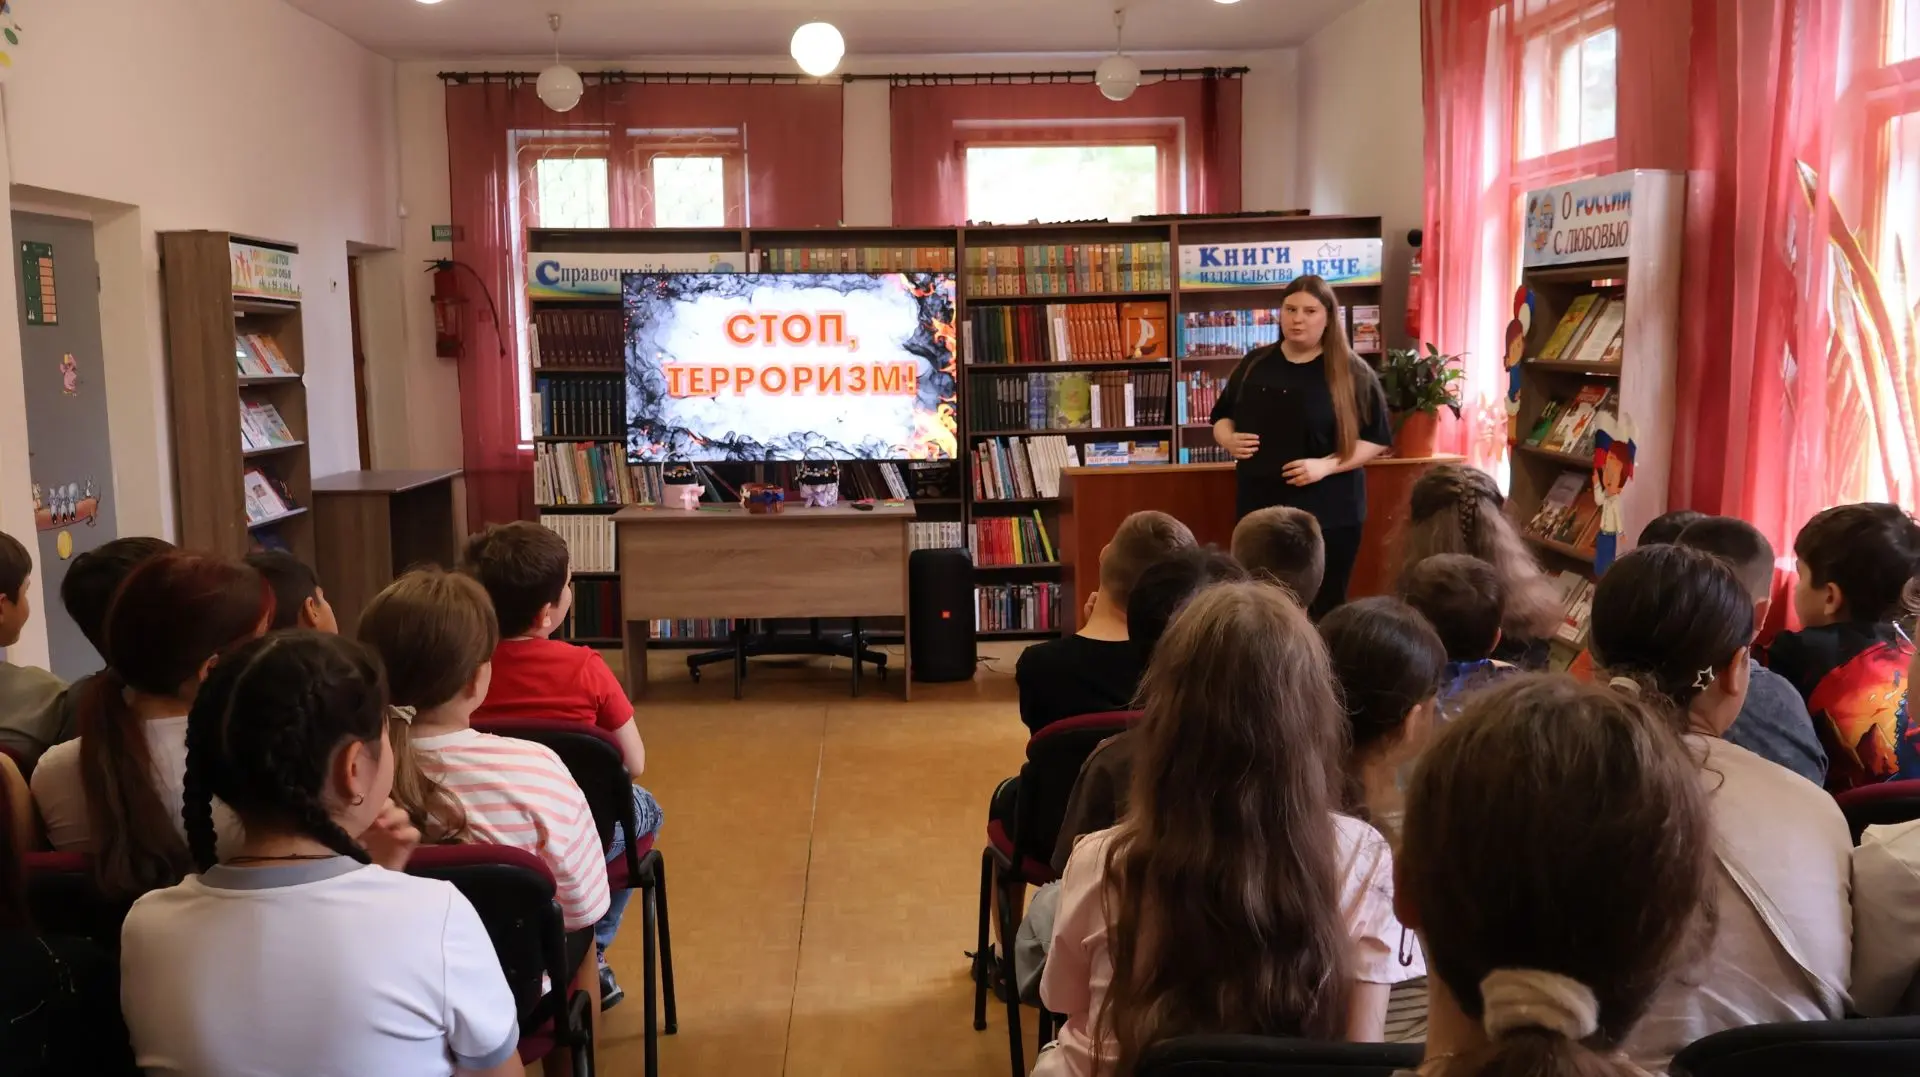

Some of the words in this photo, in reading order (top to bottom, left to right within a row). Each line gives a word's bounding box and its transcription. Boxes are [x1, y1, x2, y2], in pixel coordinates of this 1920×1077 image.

[1562, 191, 1572, 220] О
[1554, 230, 1563, 255] С
[1564, 220, 1629, 254] ЛЮБОВЬЮ
[535, 259, 653, 287] Справоч
[1200, 267, 1293, 283] издательства
[1302, 258, 1361, 276] ВЕЧЕ
[726, 313, 857, 351] СТОП,
[667, 365, 918, 394] ТЕРРОРИЗМ!
